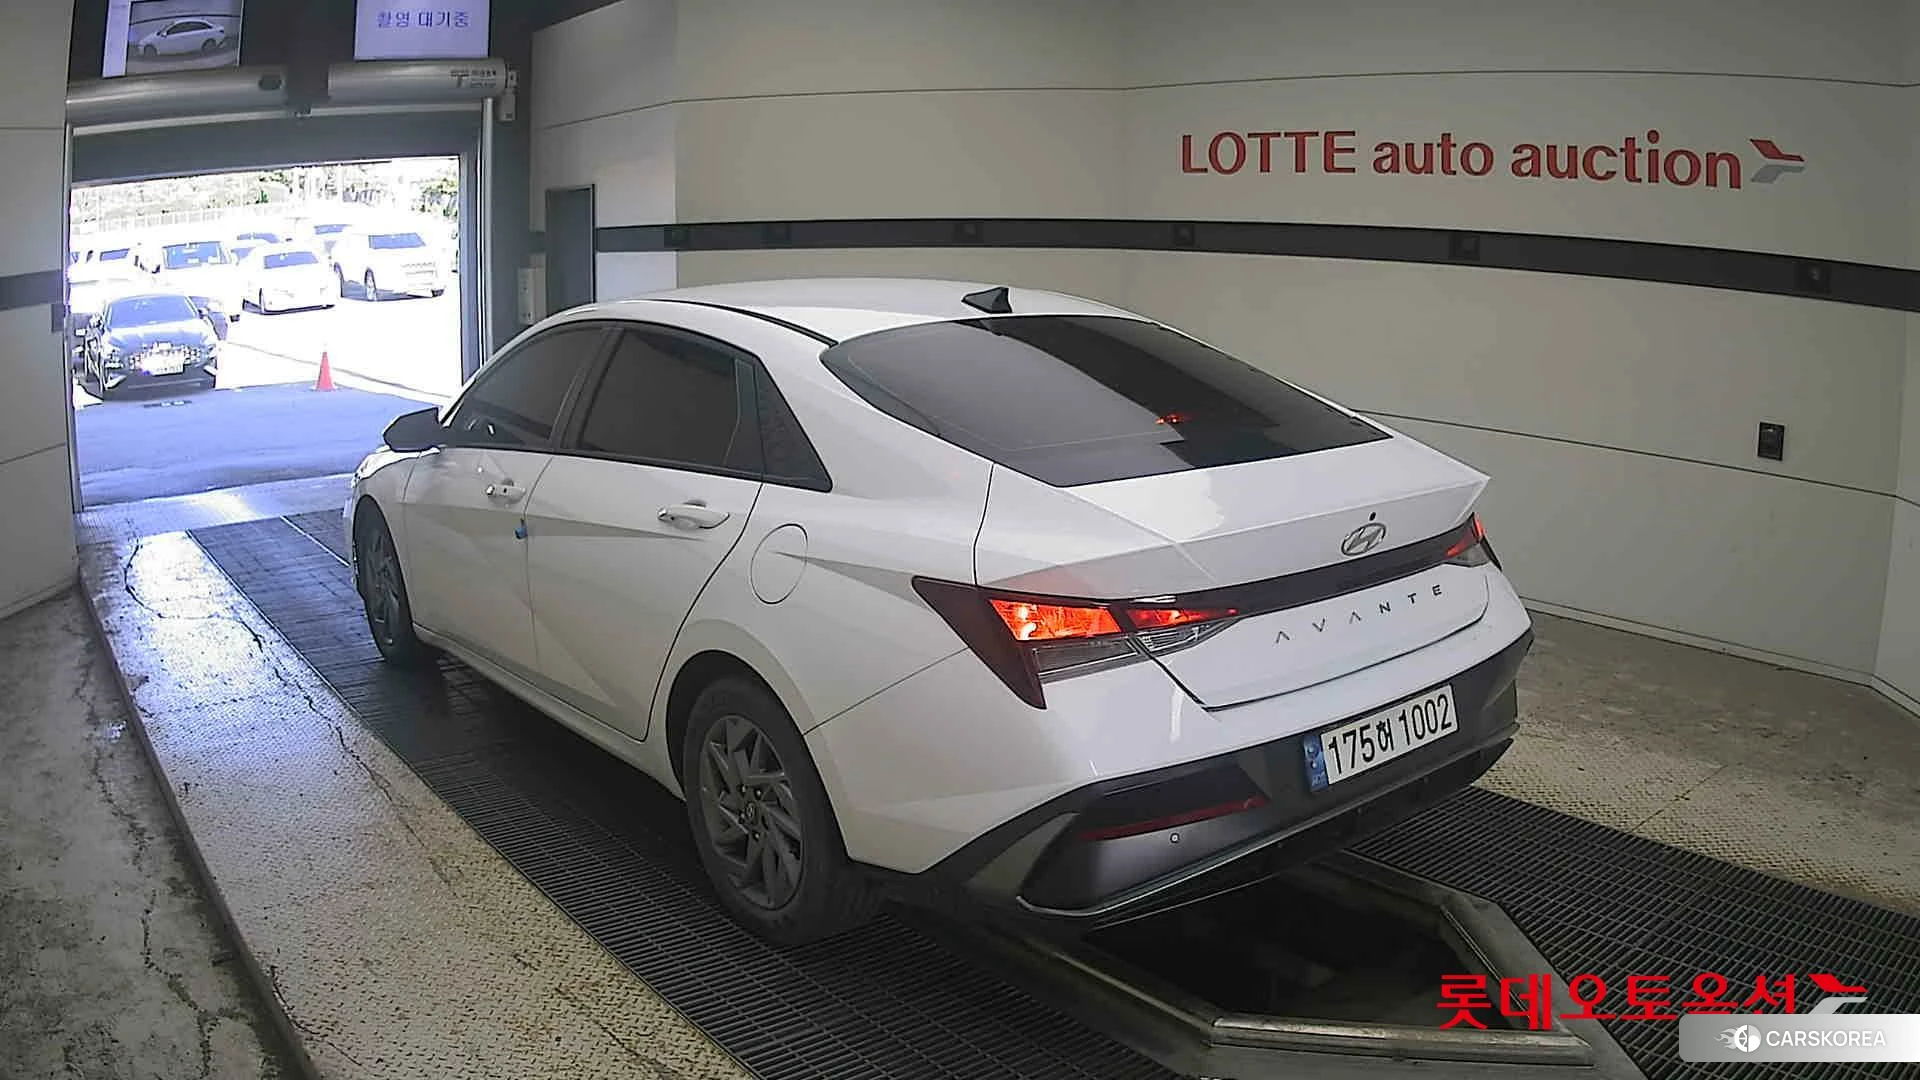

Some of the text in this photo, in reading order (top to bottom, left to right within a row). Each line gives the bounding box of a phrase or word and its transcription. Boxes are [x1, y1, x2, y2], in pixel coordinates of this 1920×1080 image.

[417, 10, 469, 28] 대기중
[1181, 129, 1742, 189] LOTTE auto auction
[1275, 584, 1443, 644] AVANTE
[1328, 693, 1452, 774] 175허 1002
